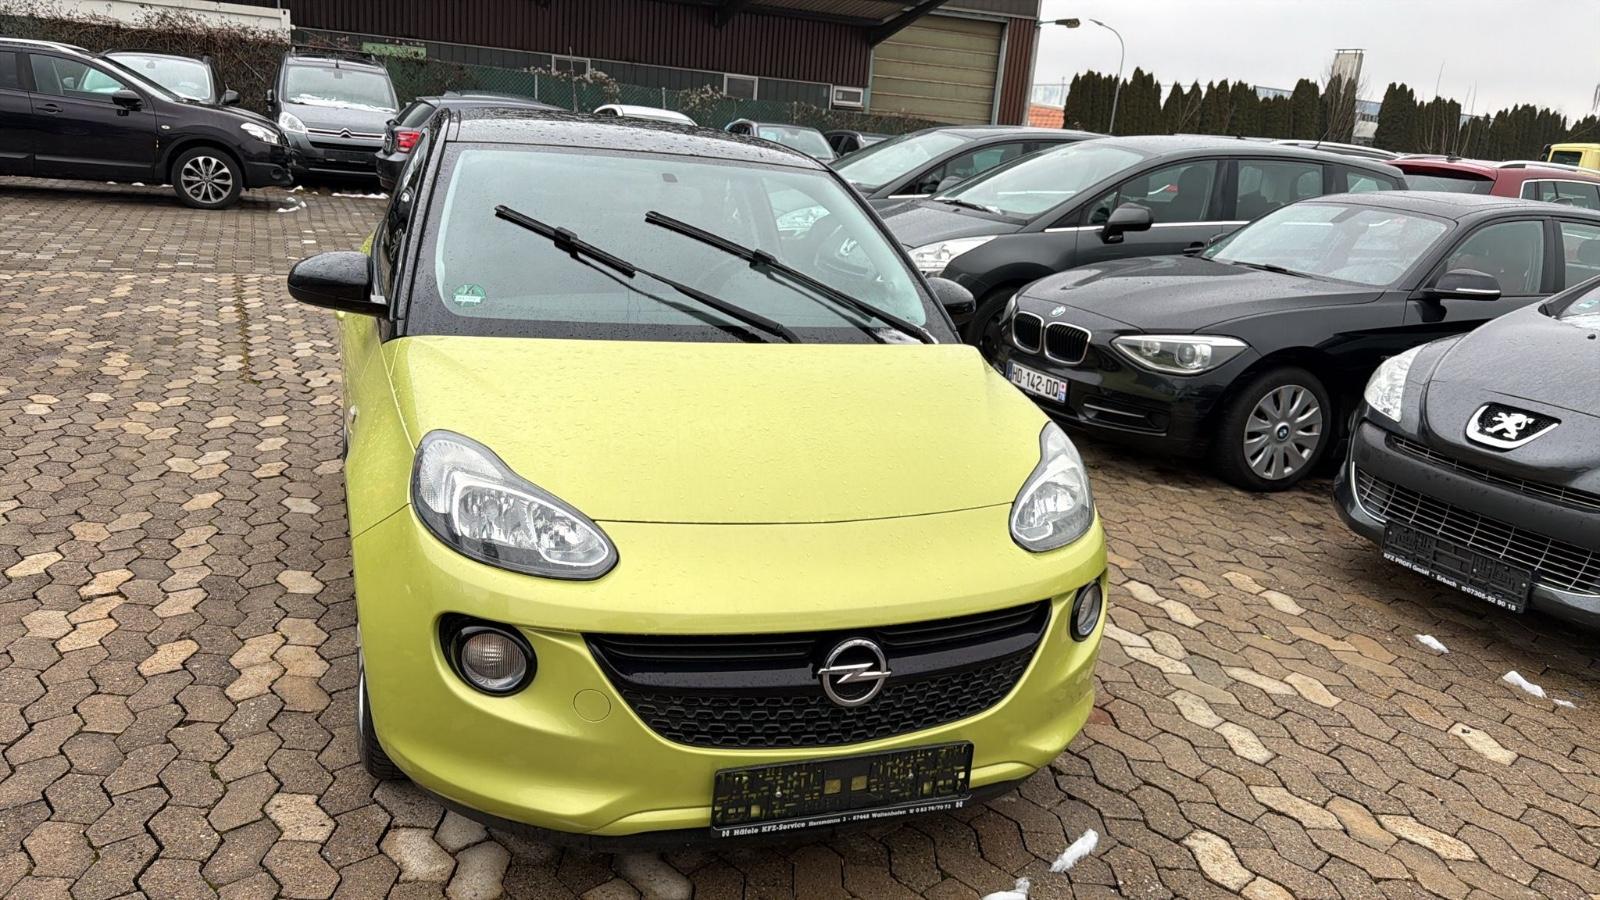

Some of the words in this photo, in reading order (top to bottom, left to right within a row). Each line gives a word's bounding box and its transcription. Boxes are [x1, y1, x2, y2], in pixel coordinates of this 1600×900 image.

[1395, 557, 1412, 569] PROFI
[1436, 574, 1457, 588] Erbach
[761, 821, 806, 833] KFZ-Service
